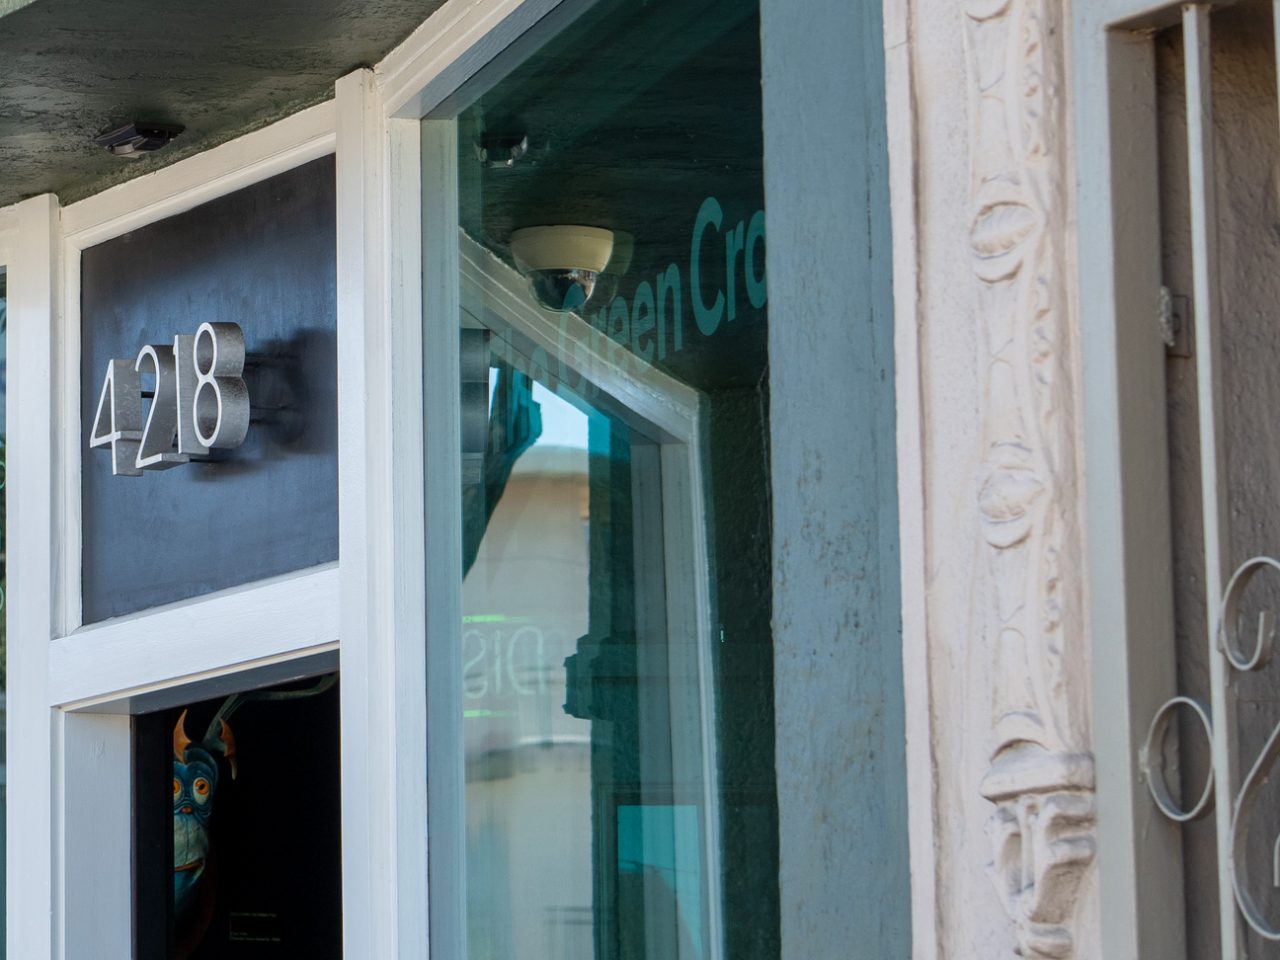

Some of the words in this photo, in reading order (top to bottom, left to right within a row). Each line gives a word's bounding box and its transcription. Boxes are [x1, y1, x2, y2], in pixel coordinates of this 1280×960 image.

[557, 263, 684, 410] Green
[690, 196, 767, 337] Cro
[90, 322, 224, 475] 4218
